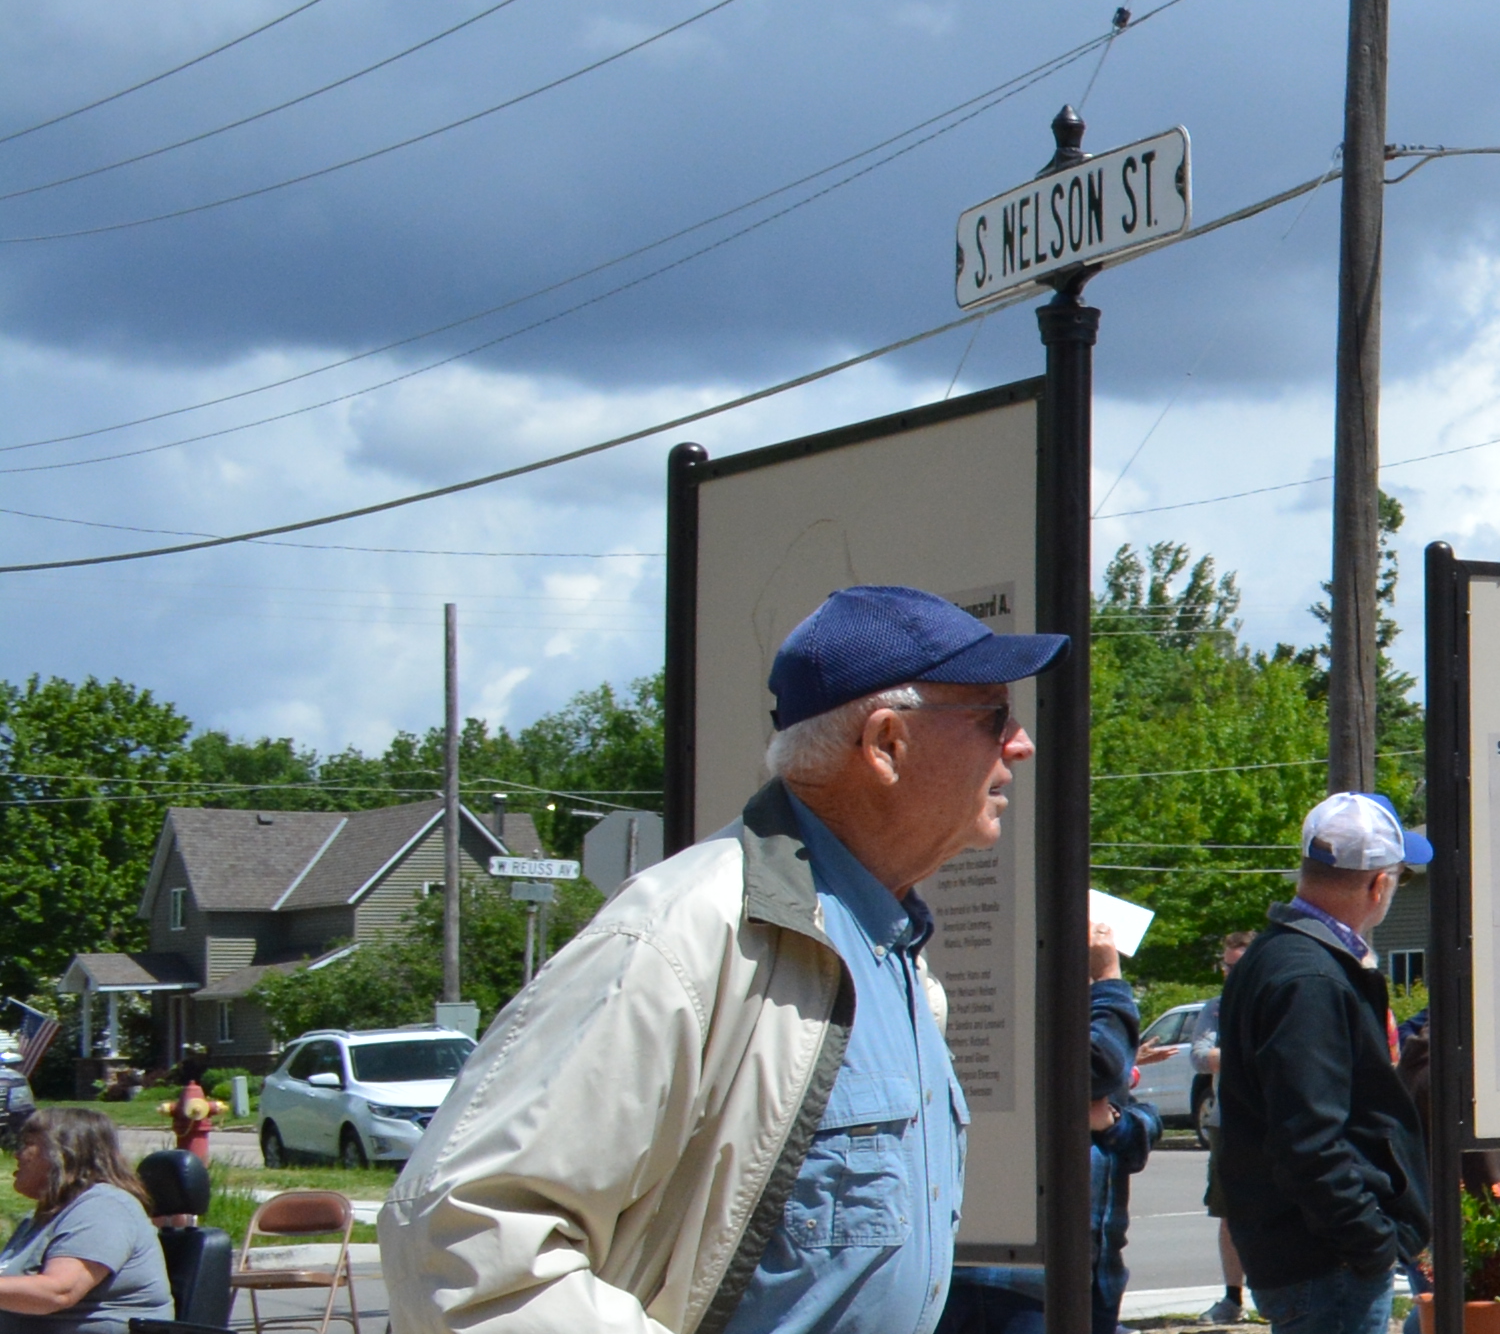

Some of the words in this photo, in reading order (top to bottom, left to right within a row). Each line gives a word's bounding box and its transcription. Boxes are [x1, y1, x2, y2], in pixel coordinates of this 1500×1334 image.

[974, 215, 992, 289] S.
[1003, 167, 1104, 277] NELSON
[1121, 149, 1158, 234] ST.
[998, 593, 1011, 615] A.
[512, 861, 553, 876] REUSS
